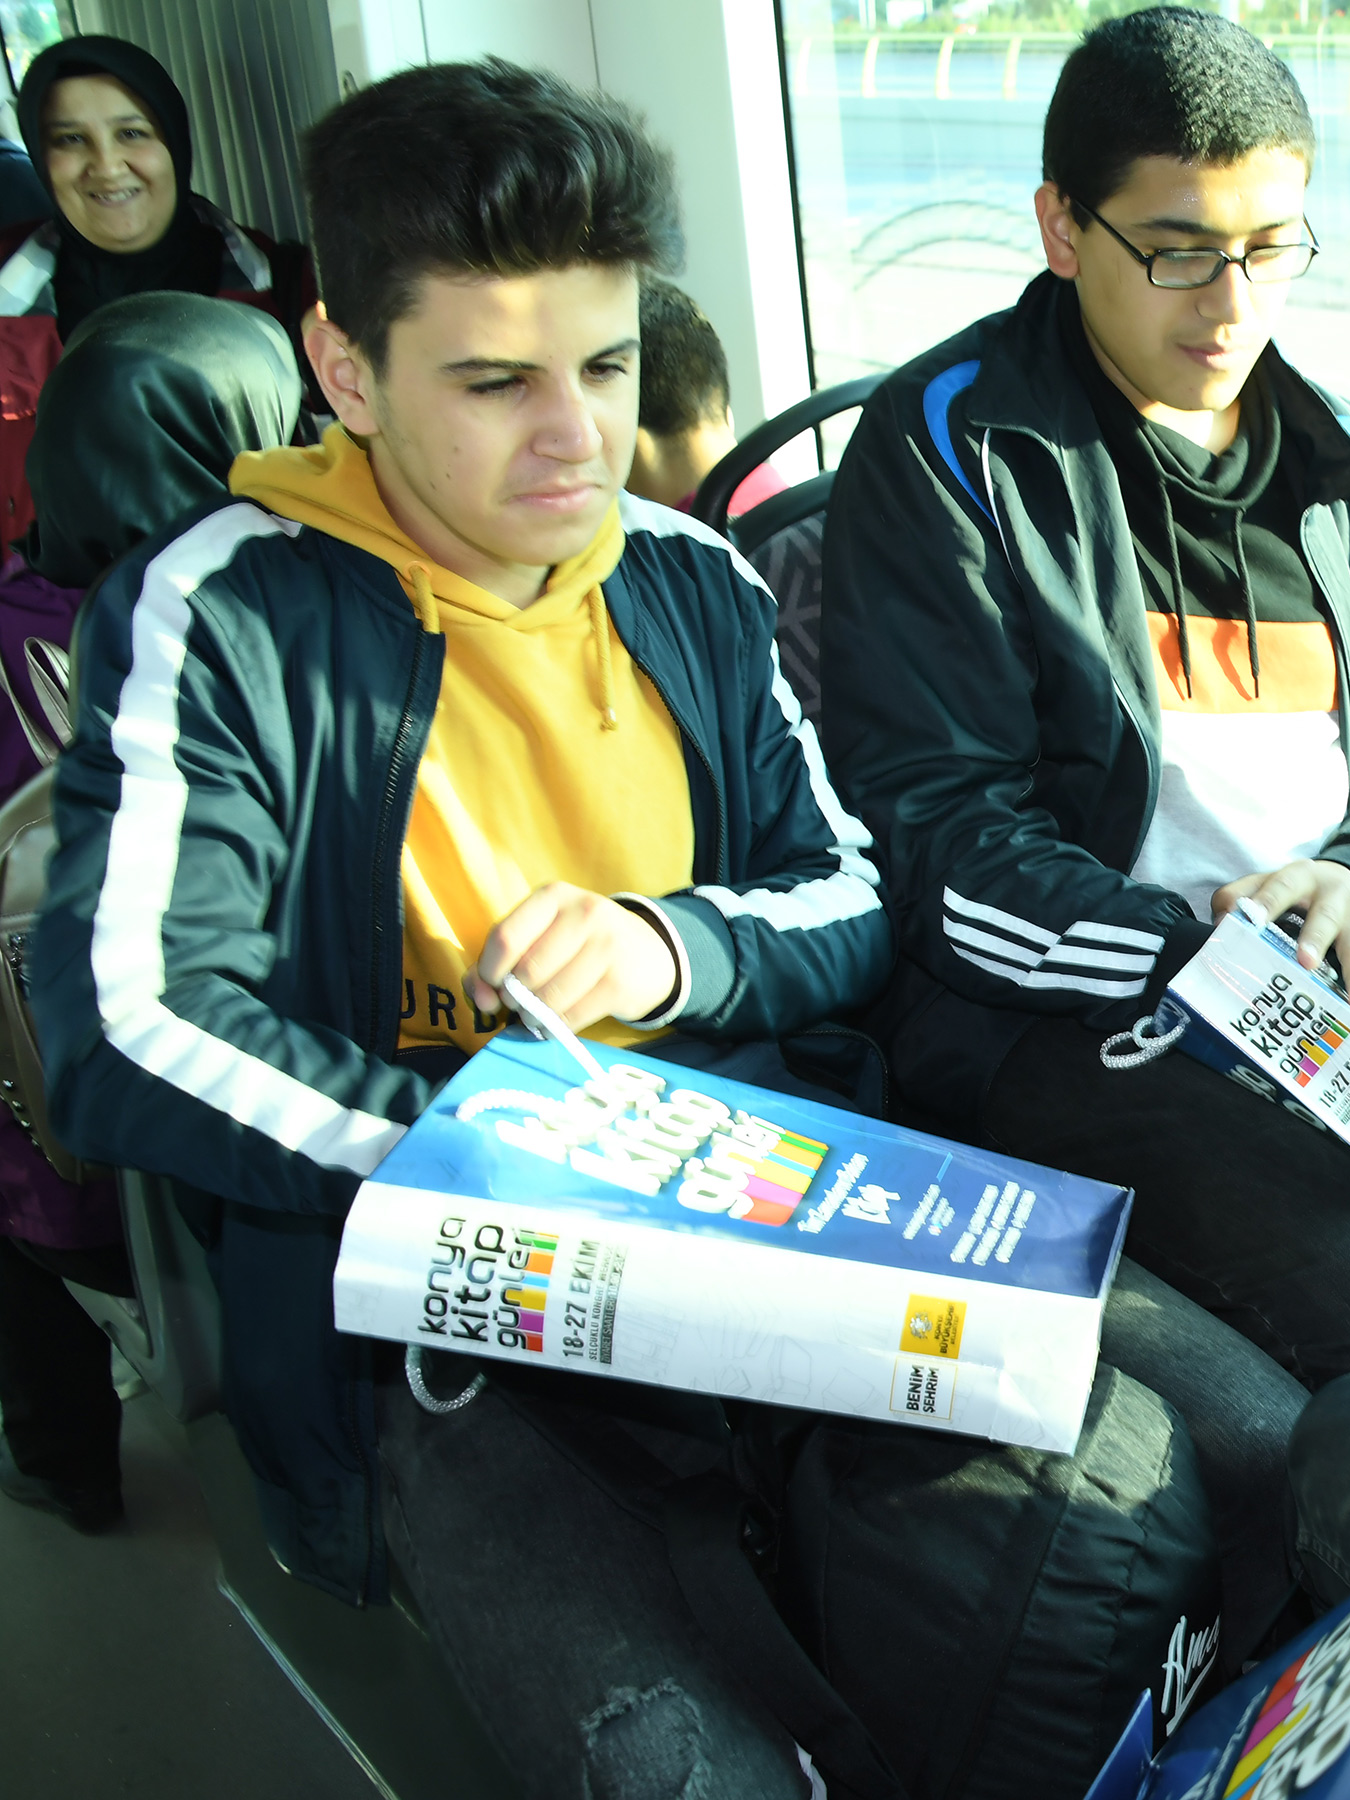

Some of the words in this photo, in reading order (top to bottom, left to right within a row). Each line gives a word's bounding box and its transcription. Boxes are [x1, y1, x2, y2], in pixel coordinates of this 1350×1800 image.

[1230, 973, 1292, 1037] konya
[1250, 992, 1315, 1058] kitap
[1280, 1006, 1336, 1079] günleri
[1319, 1070, 1350, 1108] 18-27
[418, 1217, 466, 1335] konya
[450, 1225, 506, 1341] kitap
[493, 1228, 536, 1349] günleri
[563, 1301, 587, 1357] 18-27
[589, 1321, 598, 1360] SELÇUKLU
[906, 1364, 924, 1411] BENİM
[923, 1366, 939, 1413] ŞEHRİM
